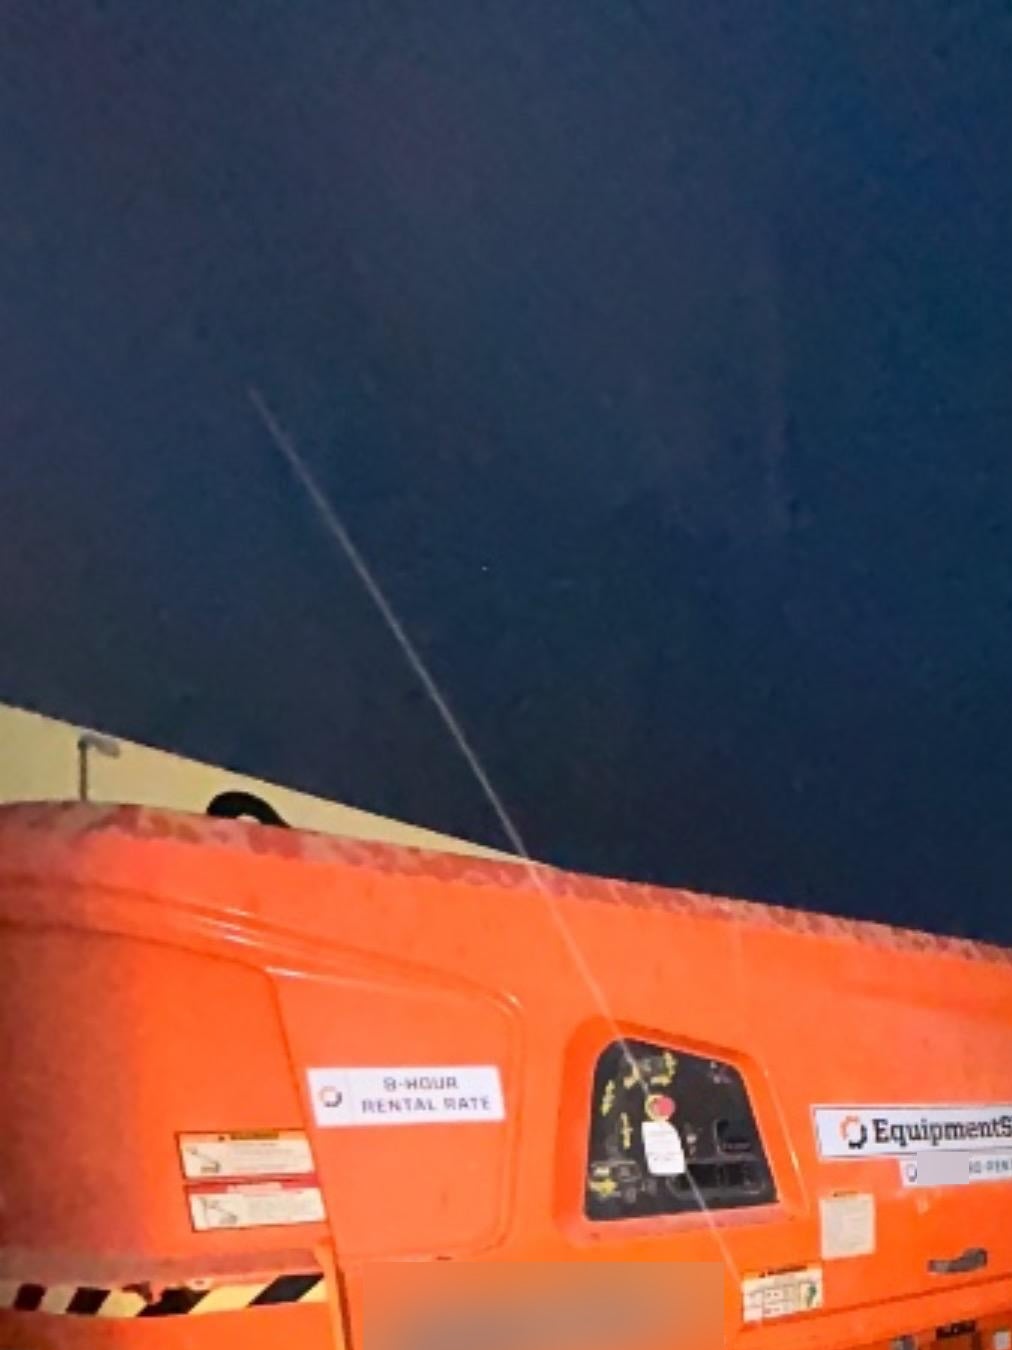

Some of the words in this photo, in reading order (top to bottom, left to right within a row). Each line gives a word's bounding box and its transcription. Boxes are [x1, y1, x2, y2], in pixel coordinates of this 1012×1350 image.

[383, 1076, 458, 1092] 8-HOUR
[361, 1097, 437, 1114] RENTAL
[443, 1095, 491, 1111] RATE
